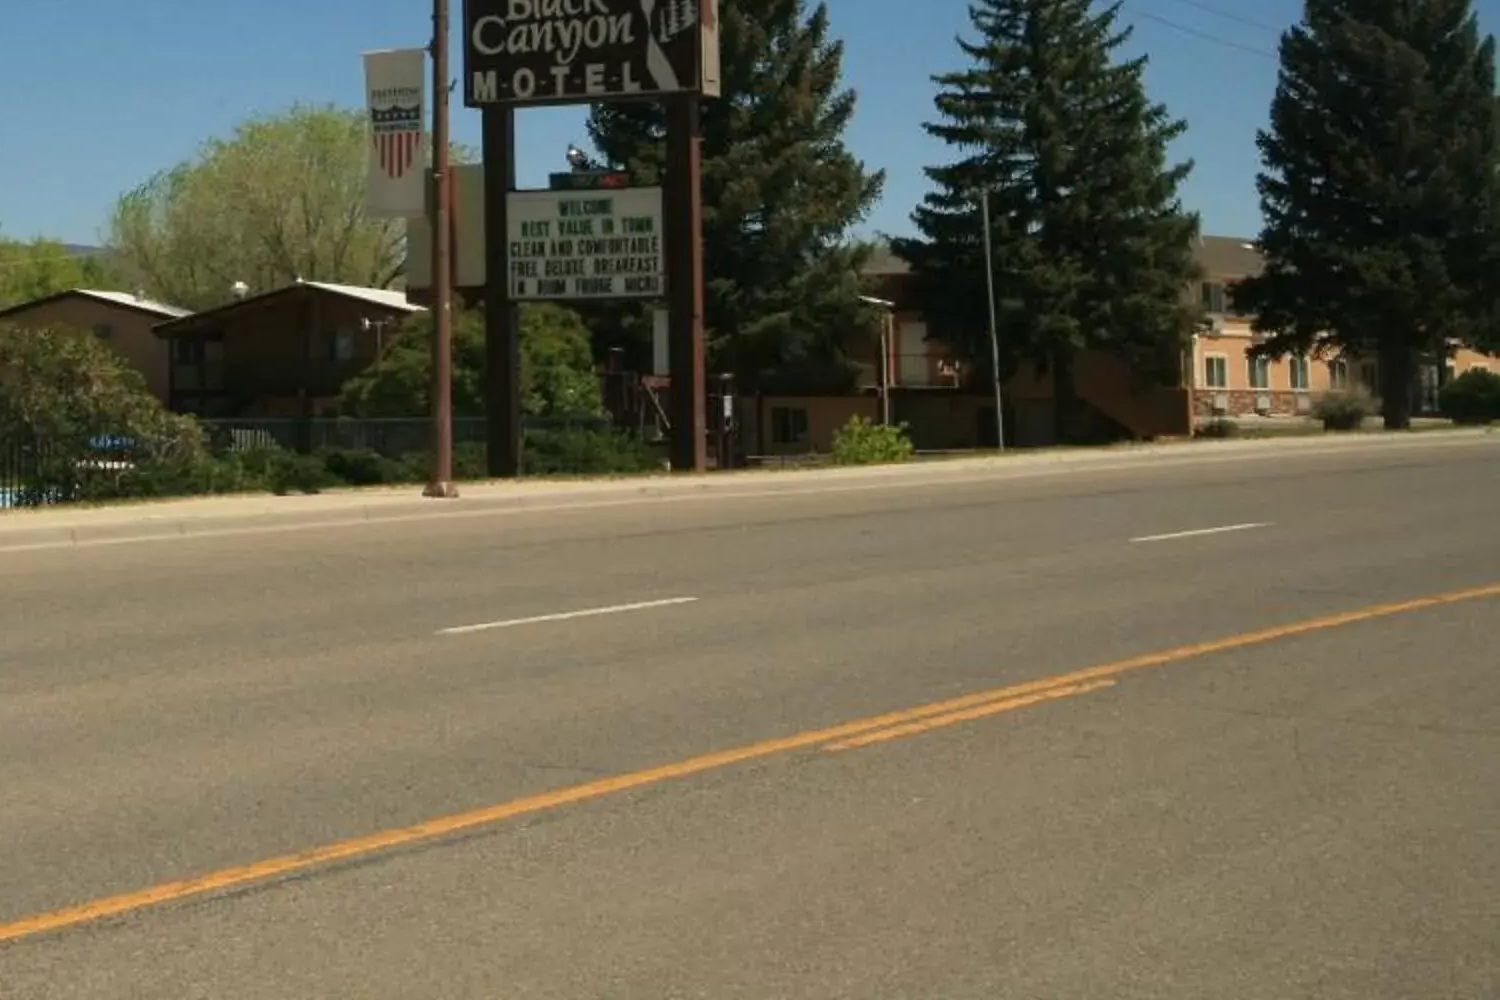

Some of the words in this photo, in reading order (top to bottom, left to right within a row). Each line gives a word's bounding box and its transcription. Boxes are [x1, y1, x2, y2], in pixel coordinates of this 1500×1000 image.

[472, 12, 635, 64] Canyon
[558, 199, 612, 217] WELCOME
[558, 218, 594, 236] VALUE
[622, 216, 653, 233] TOWN
[510, 240, 545, 257] CLEAN
[550, 239, 573, 256] AND
[577, 236, 659, 255] COMFORTABLE
[511, 260, 538, 278] FREE
[545, 258, 585, 276] DELUXE
[594, 256, 659, 275] BREAKFAST
